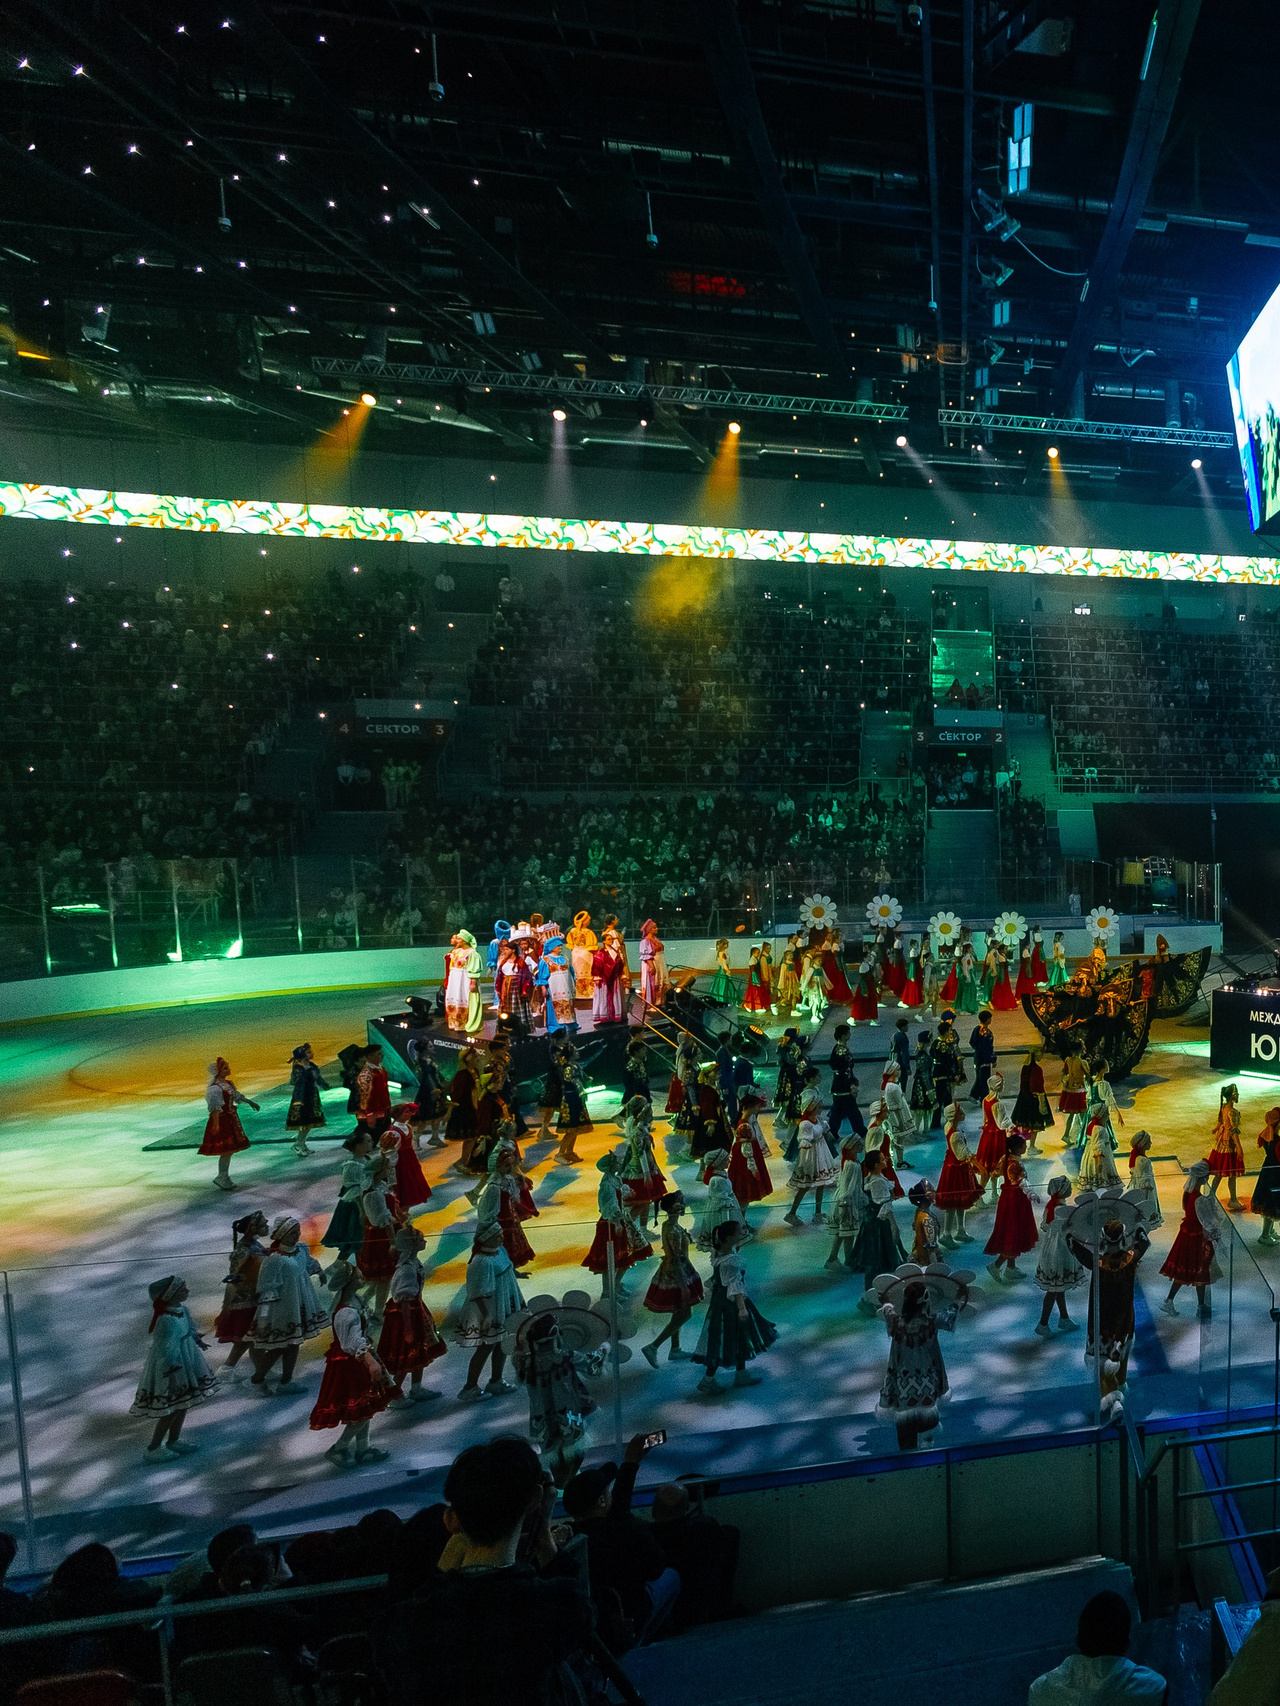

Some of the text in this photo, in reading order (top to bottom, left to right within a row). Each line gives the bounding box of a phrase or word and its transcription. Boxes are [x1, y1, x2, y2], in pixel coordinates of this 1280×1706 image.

[339, 723, 444, 735] 4 СЕКТОР 3
[916, 732, 1003, 742] 3 СЕКТОР 2
